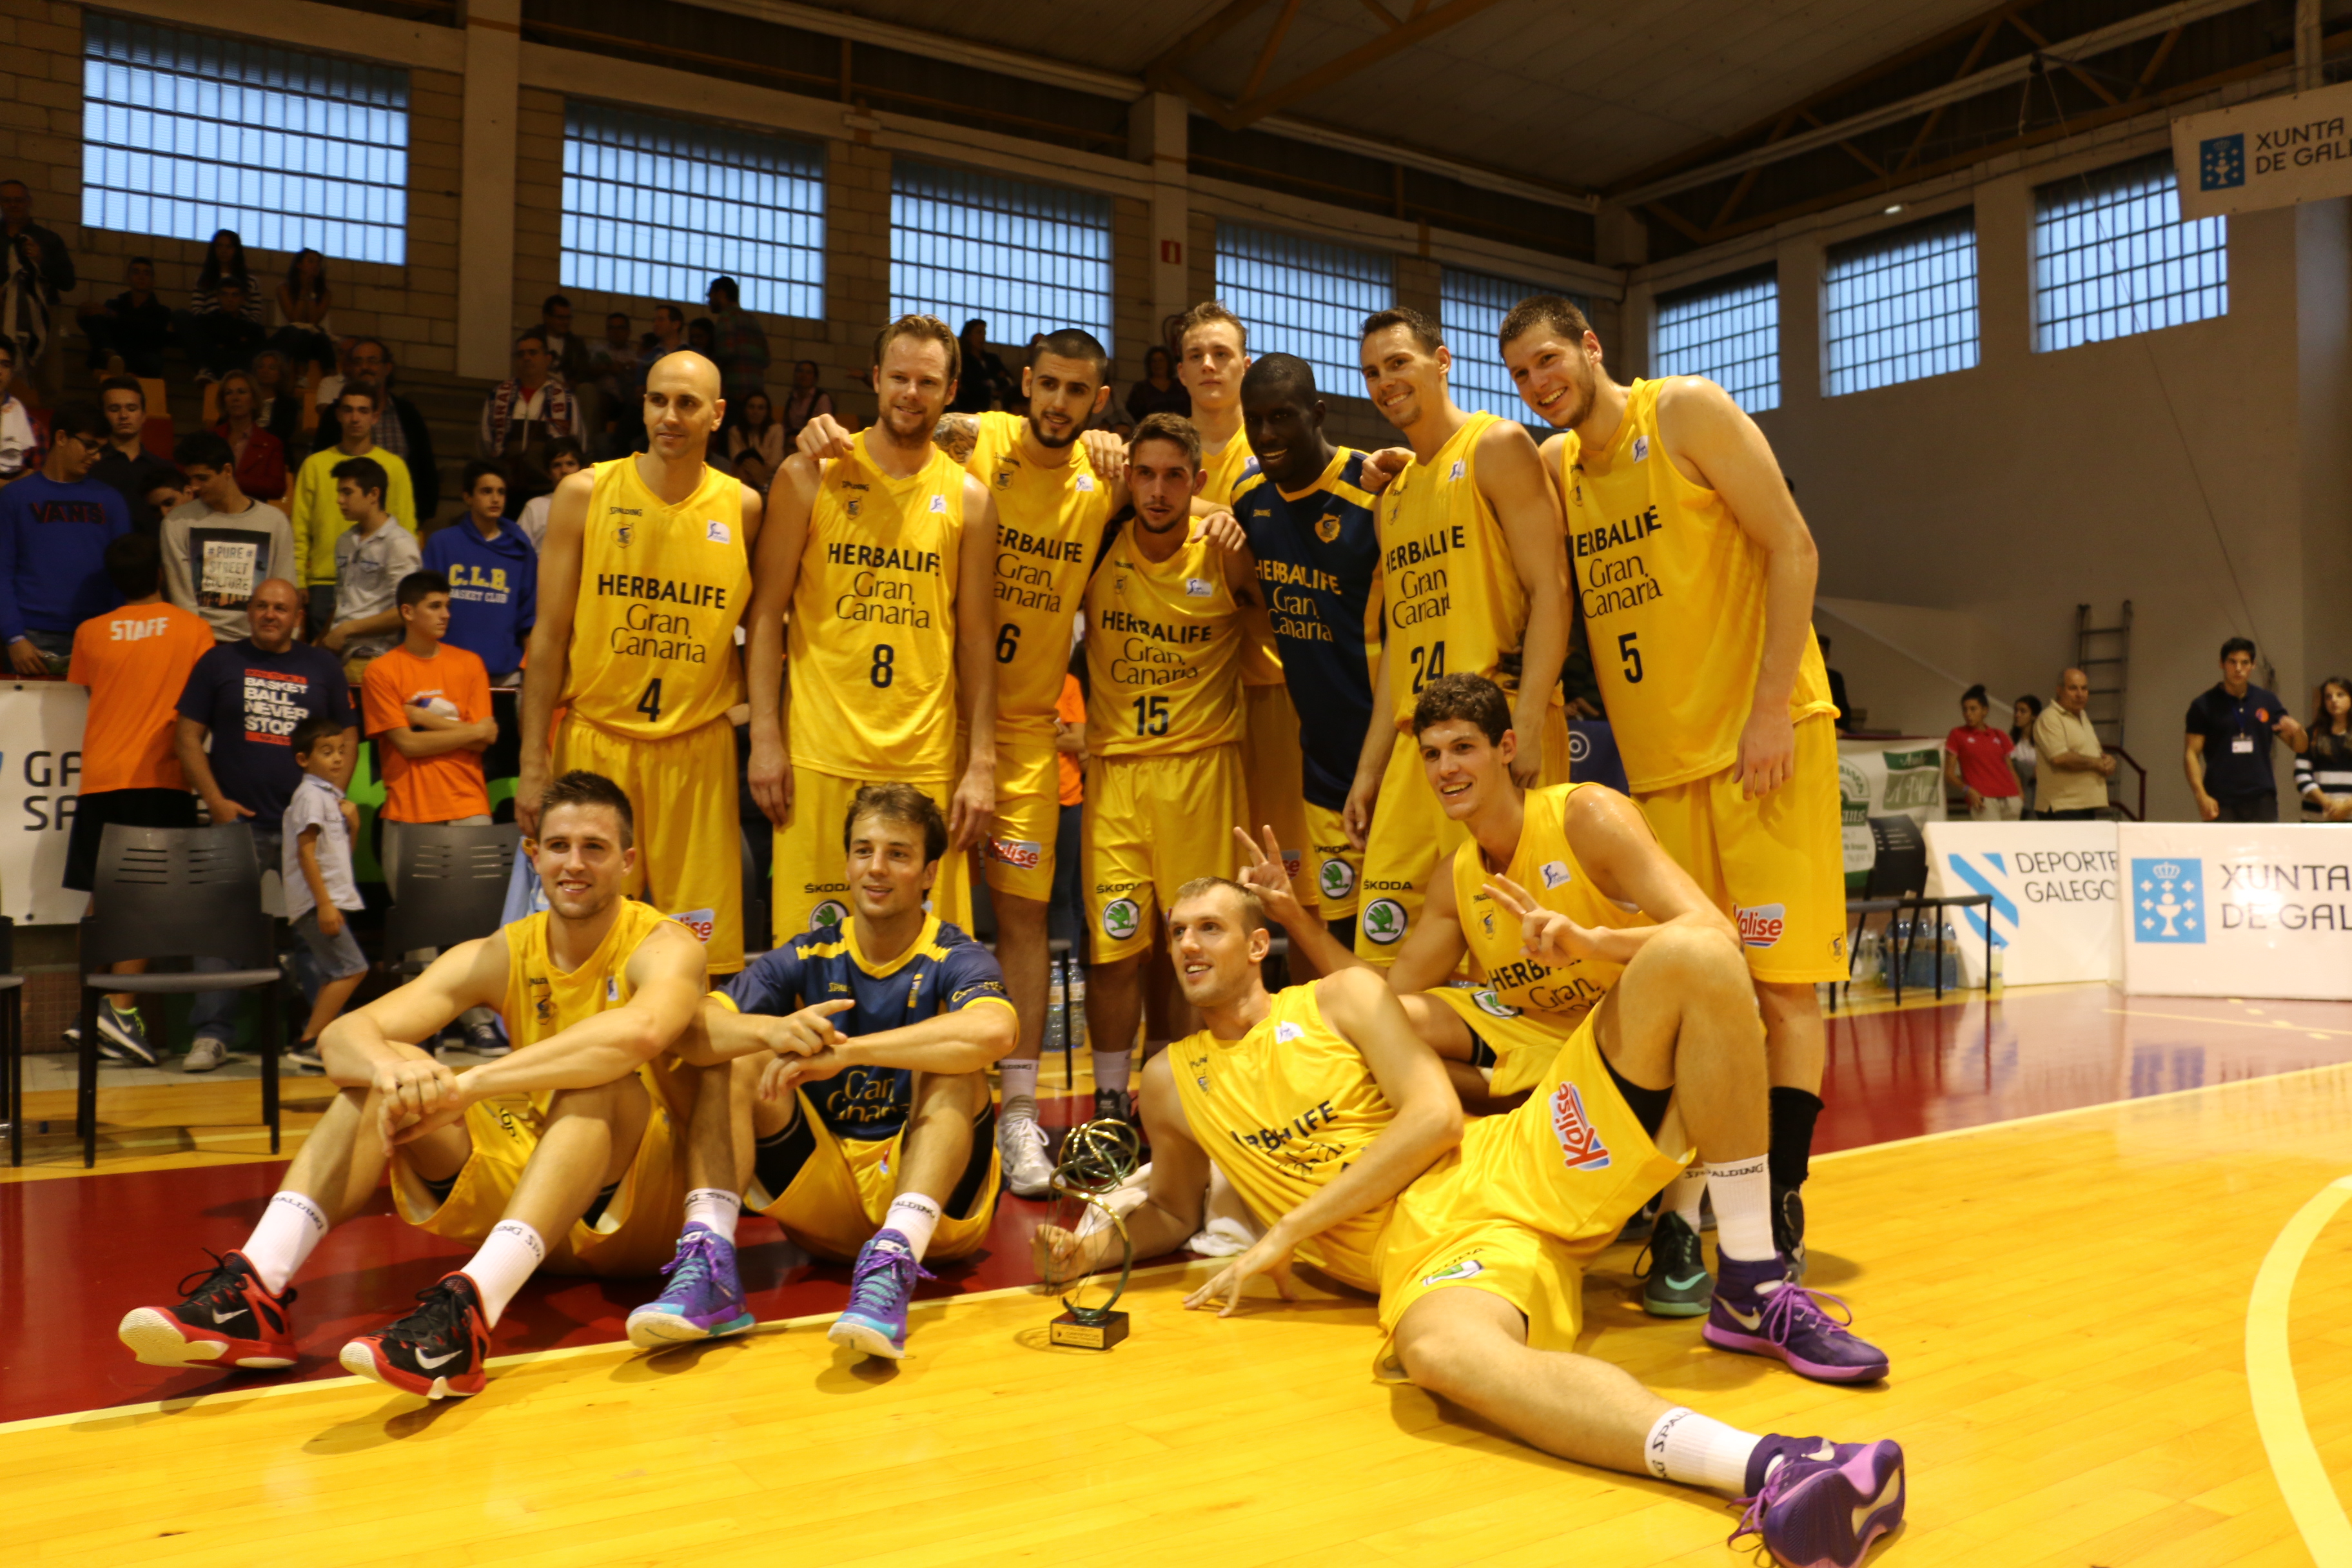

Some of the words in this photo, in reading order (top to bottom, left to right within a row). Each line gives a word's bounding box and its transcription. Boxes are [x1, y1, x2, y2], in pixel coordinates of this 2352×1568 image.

[2256, 117, 2344, 152] XUNTA
[2256, 152, 2286, 175] DE
[30, 500, 106, 525] VANS
[609, 506, 643, 517] SPALDING
[210, 560, 249, 575] STREET
[217, 545, 243, 559] PURE
[995, 553, 1053, 582] Gran
[448, 564, 511, 594] C.L.B.
[854, 571, 913, 602] Gran
[1401, 568, 1447, 600] Gran
[1589, 555, 1644, 589] Gran
[598, 573, 726, 610] HERBALIFE
[994, 578, 1061, 613] anaria
[1273, 586, 1319, 617] Gran
[626, 603, 690, 636] Gran
[835, 594, 930, 629] Canaria
[1101, 609, 1212, 644] HERBALIFE
[110, 616, 170, 642] STAFF
[995, 622, 1021, 665] 6
[611, 627, 707, 663] Canaria
[1123, 637, 1182, 666] Gran
[1617, 631, 1643, 684] 5
[870, 643, 894, 689] 8
[1110, 658, 1199, 686] Canaria
[1410, 640, 1446, 695] 24
[244, 676, 308, 694] BASKET
[244, 687, 296, 707] BALL
[636, 677, 662, 723] 4
[244, 700, 309, 721] NEVER
[244, 714, 297, 736] STOP
[1132, 695, 1169, 736] 15
[1363, 879, 1414, 890] ŠKODA
[2220, 864, 2351, 891] XUNTA
[2221, 902, 2267, 929] DE
[1529, 977, 1595, 1009] Gran
[1556, 1083, 1609, 1167] Kalise
